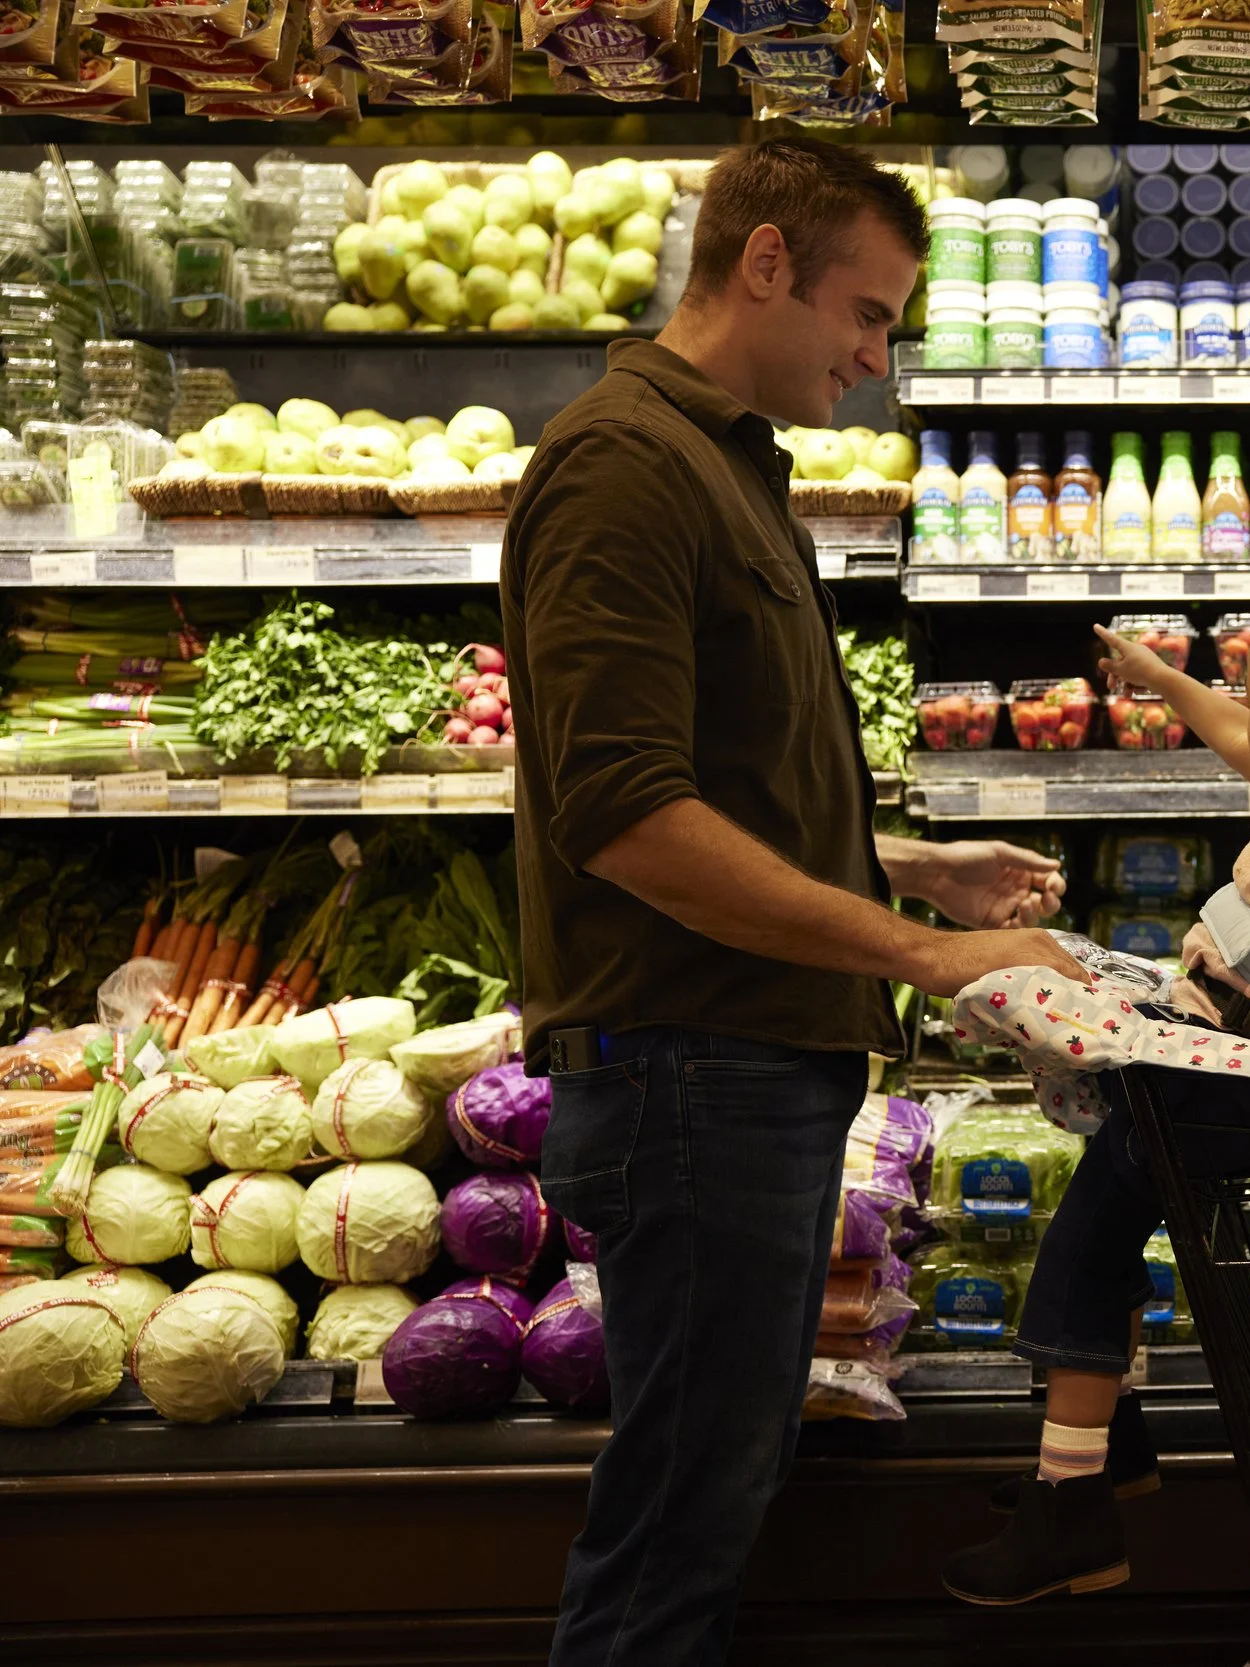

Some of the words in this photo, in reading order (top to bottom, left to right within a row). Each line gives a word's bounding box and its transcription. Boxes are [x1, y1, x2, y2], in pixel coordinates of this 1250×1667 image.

[996, 9, 1012, 18] TACOS
[1181, 29, 1203, 37] SALADS
[1209, 30, 1227, 38] TACOS
[1207, 57, 1246, 67] CRISPY
